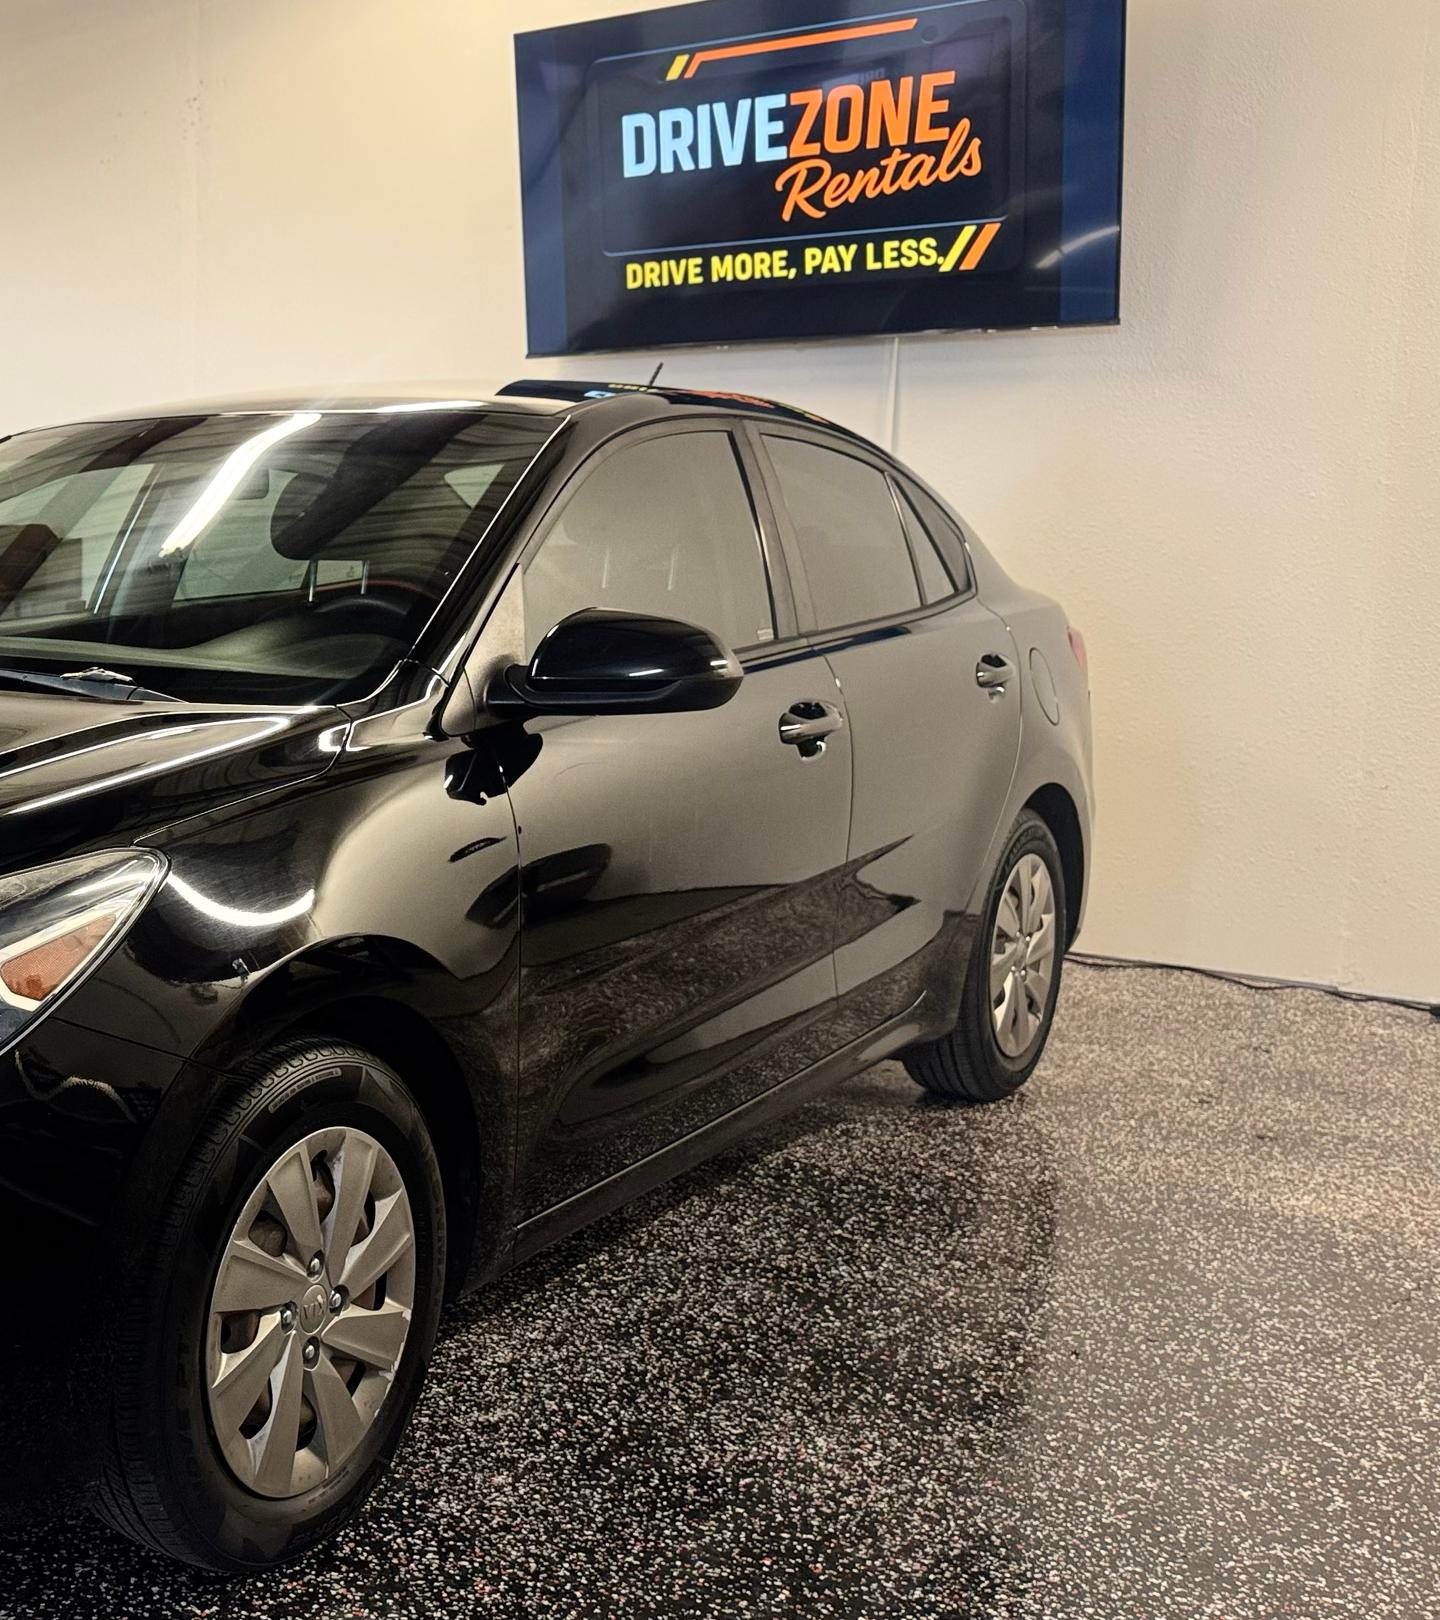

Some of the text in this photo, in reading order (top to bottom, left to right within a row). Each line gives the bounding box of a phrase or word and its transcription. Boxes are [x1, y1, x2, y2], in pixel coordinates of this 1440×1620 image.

[775, 117, 982, 222] Rentals
[626, 237, 944, 290] DRIVE MORE, PAY LESS.
